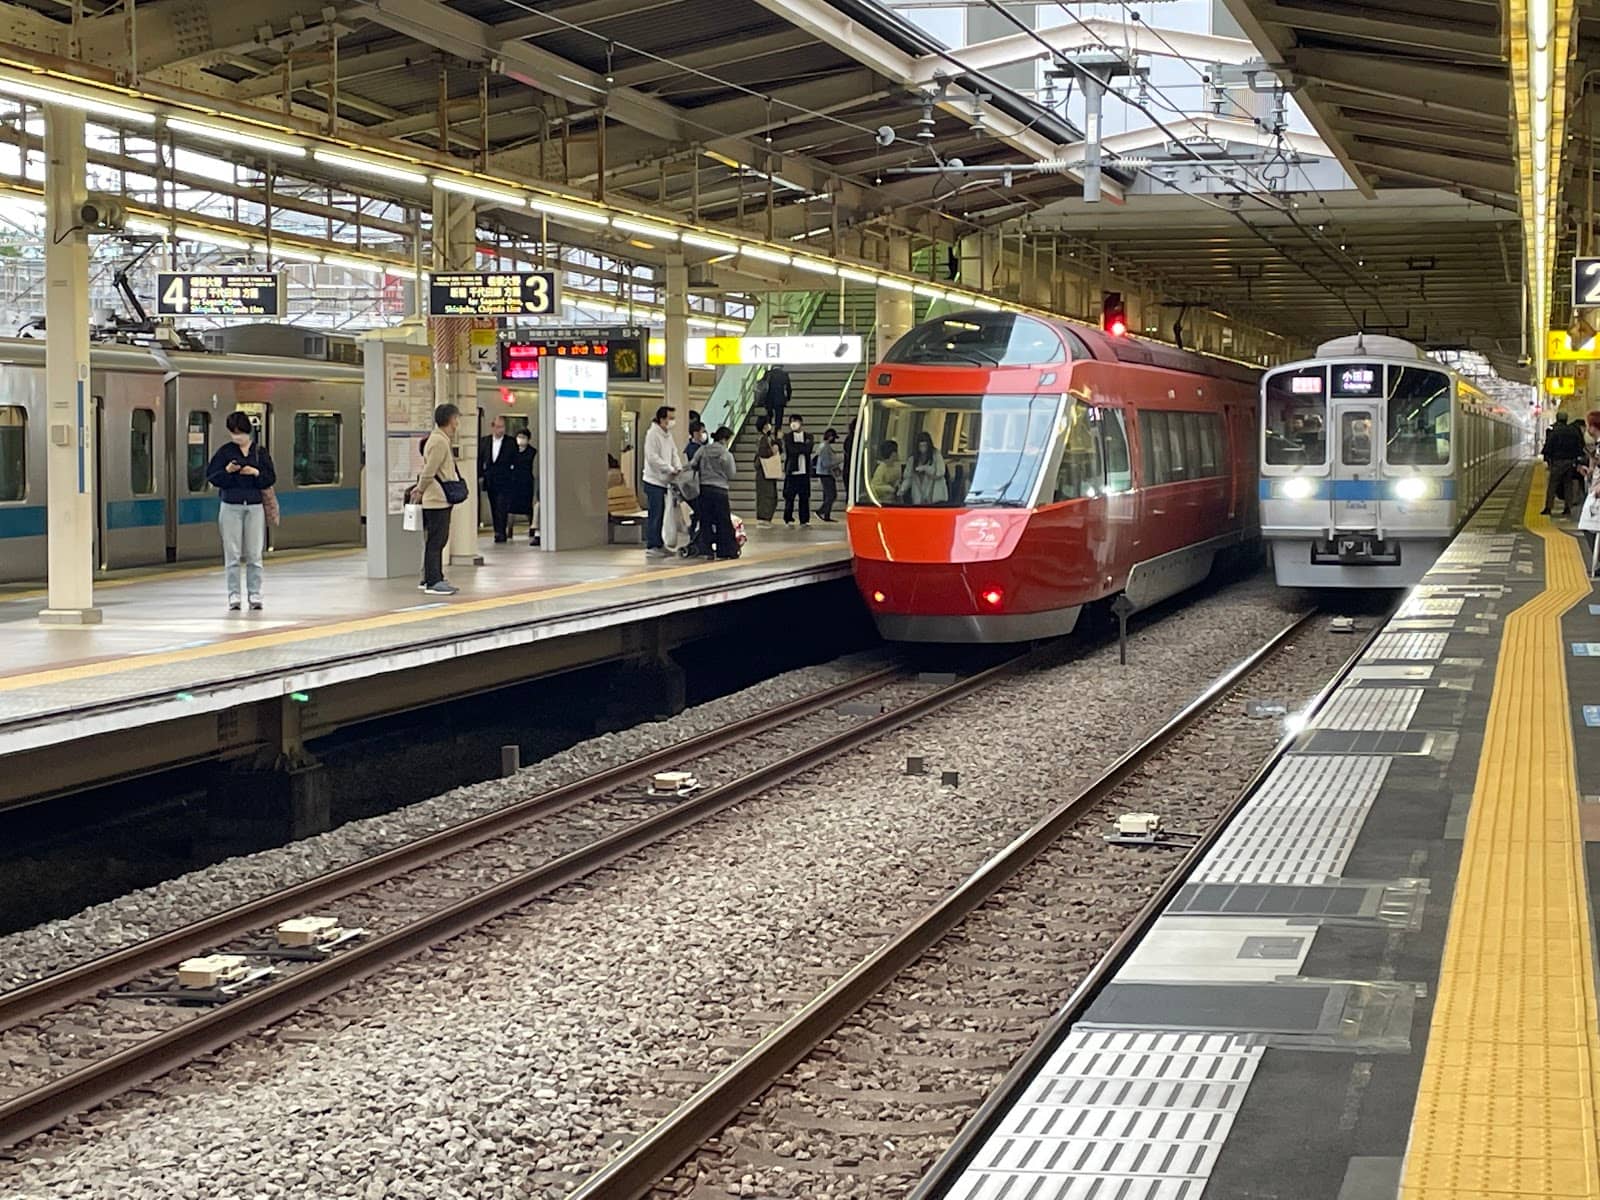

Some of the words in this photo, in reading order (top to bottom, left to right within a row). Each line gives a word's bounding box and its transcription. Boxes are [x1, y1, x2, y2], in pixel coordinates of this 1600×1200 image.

[190, 276, 222, 287] 大野
[488, 275, 521, 286] 大野
[1584, 262, 1600, 303] 2
[162, 277, 188, 313] 4
[242, 287, 259, 299] 方
[504, 286, 521, 298] 方
[524, 275, 549, 313] 3
